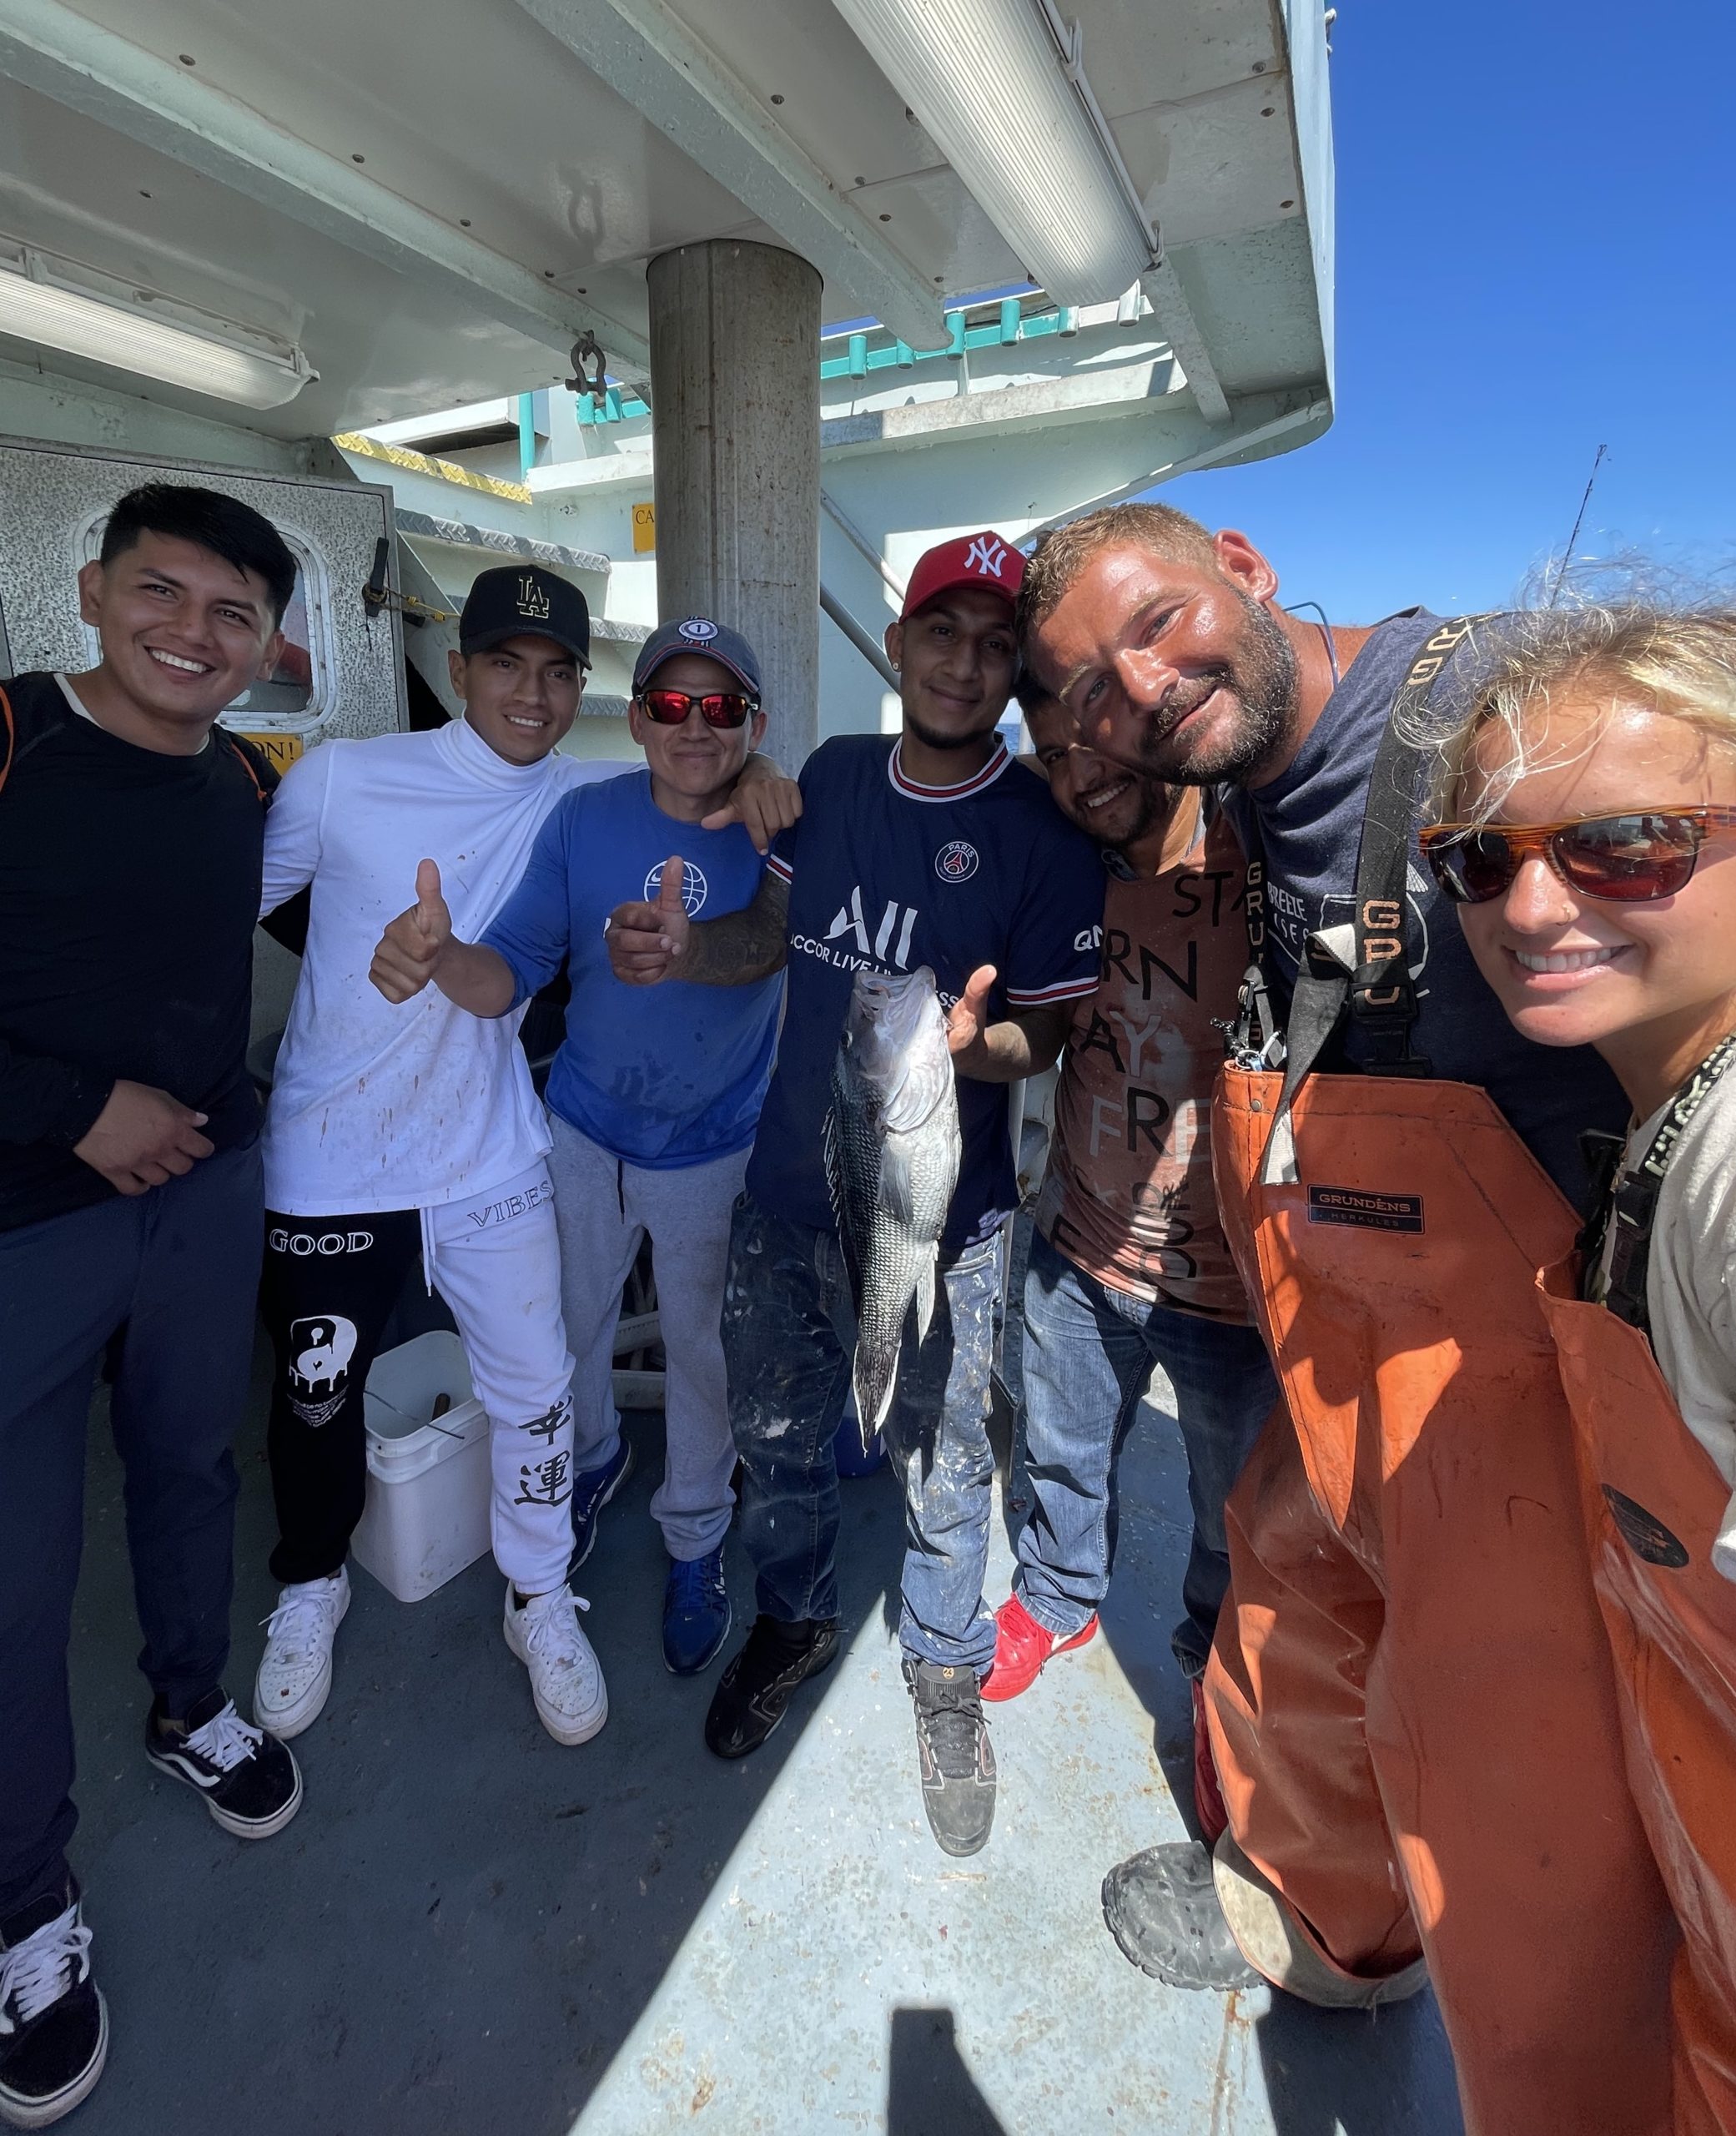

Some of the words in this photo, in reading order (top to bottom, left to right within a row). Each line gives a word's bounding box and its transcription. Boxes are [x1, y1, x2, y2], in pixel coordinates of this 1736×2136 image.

[516, 576, 549, 618] LA
[949, 844, 975, 858] PARIS
[467, 1180, 552, 1227] VIBES
[269, 1228, 374, 1255] GOOD
